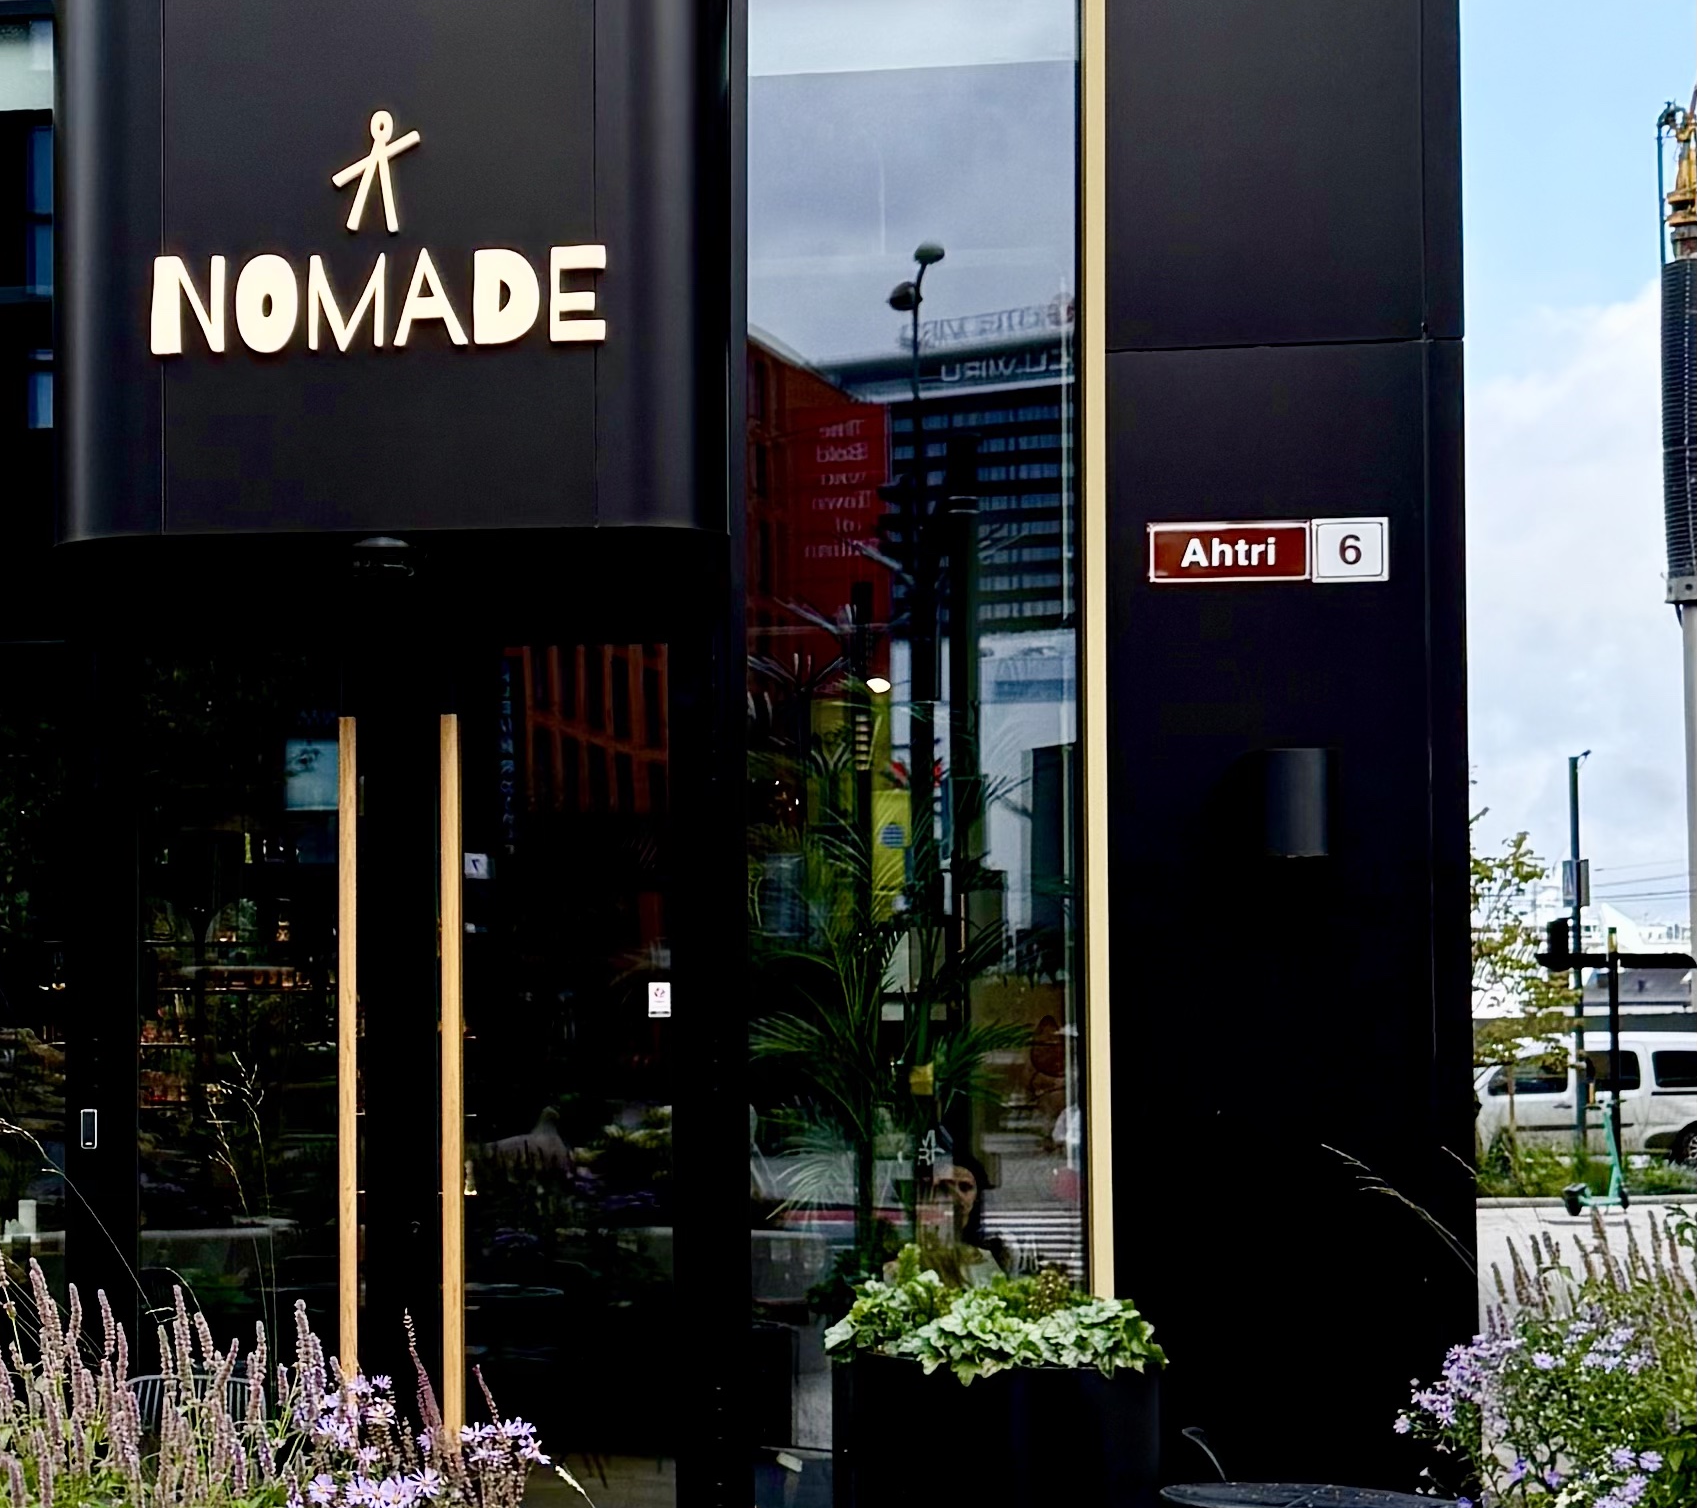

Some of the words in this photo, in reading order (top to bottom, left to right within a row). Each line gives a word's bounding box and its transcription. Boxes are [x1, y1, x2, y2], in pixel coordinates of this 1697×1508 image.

[150, 244, 607, 355] NOMADE
[1180, 537, 1277, 568] Ahtri
[1339, 534, 1363, 566] 6
